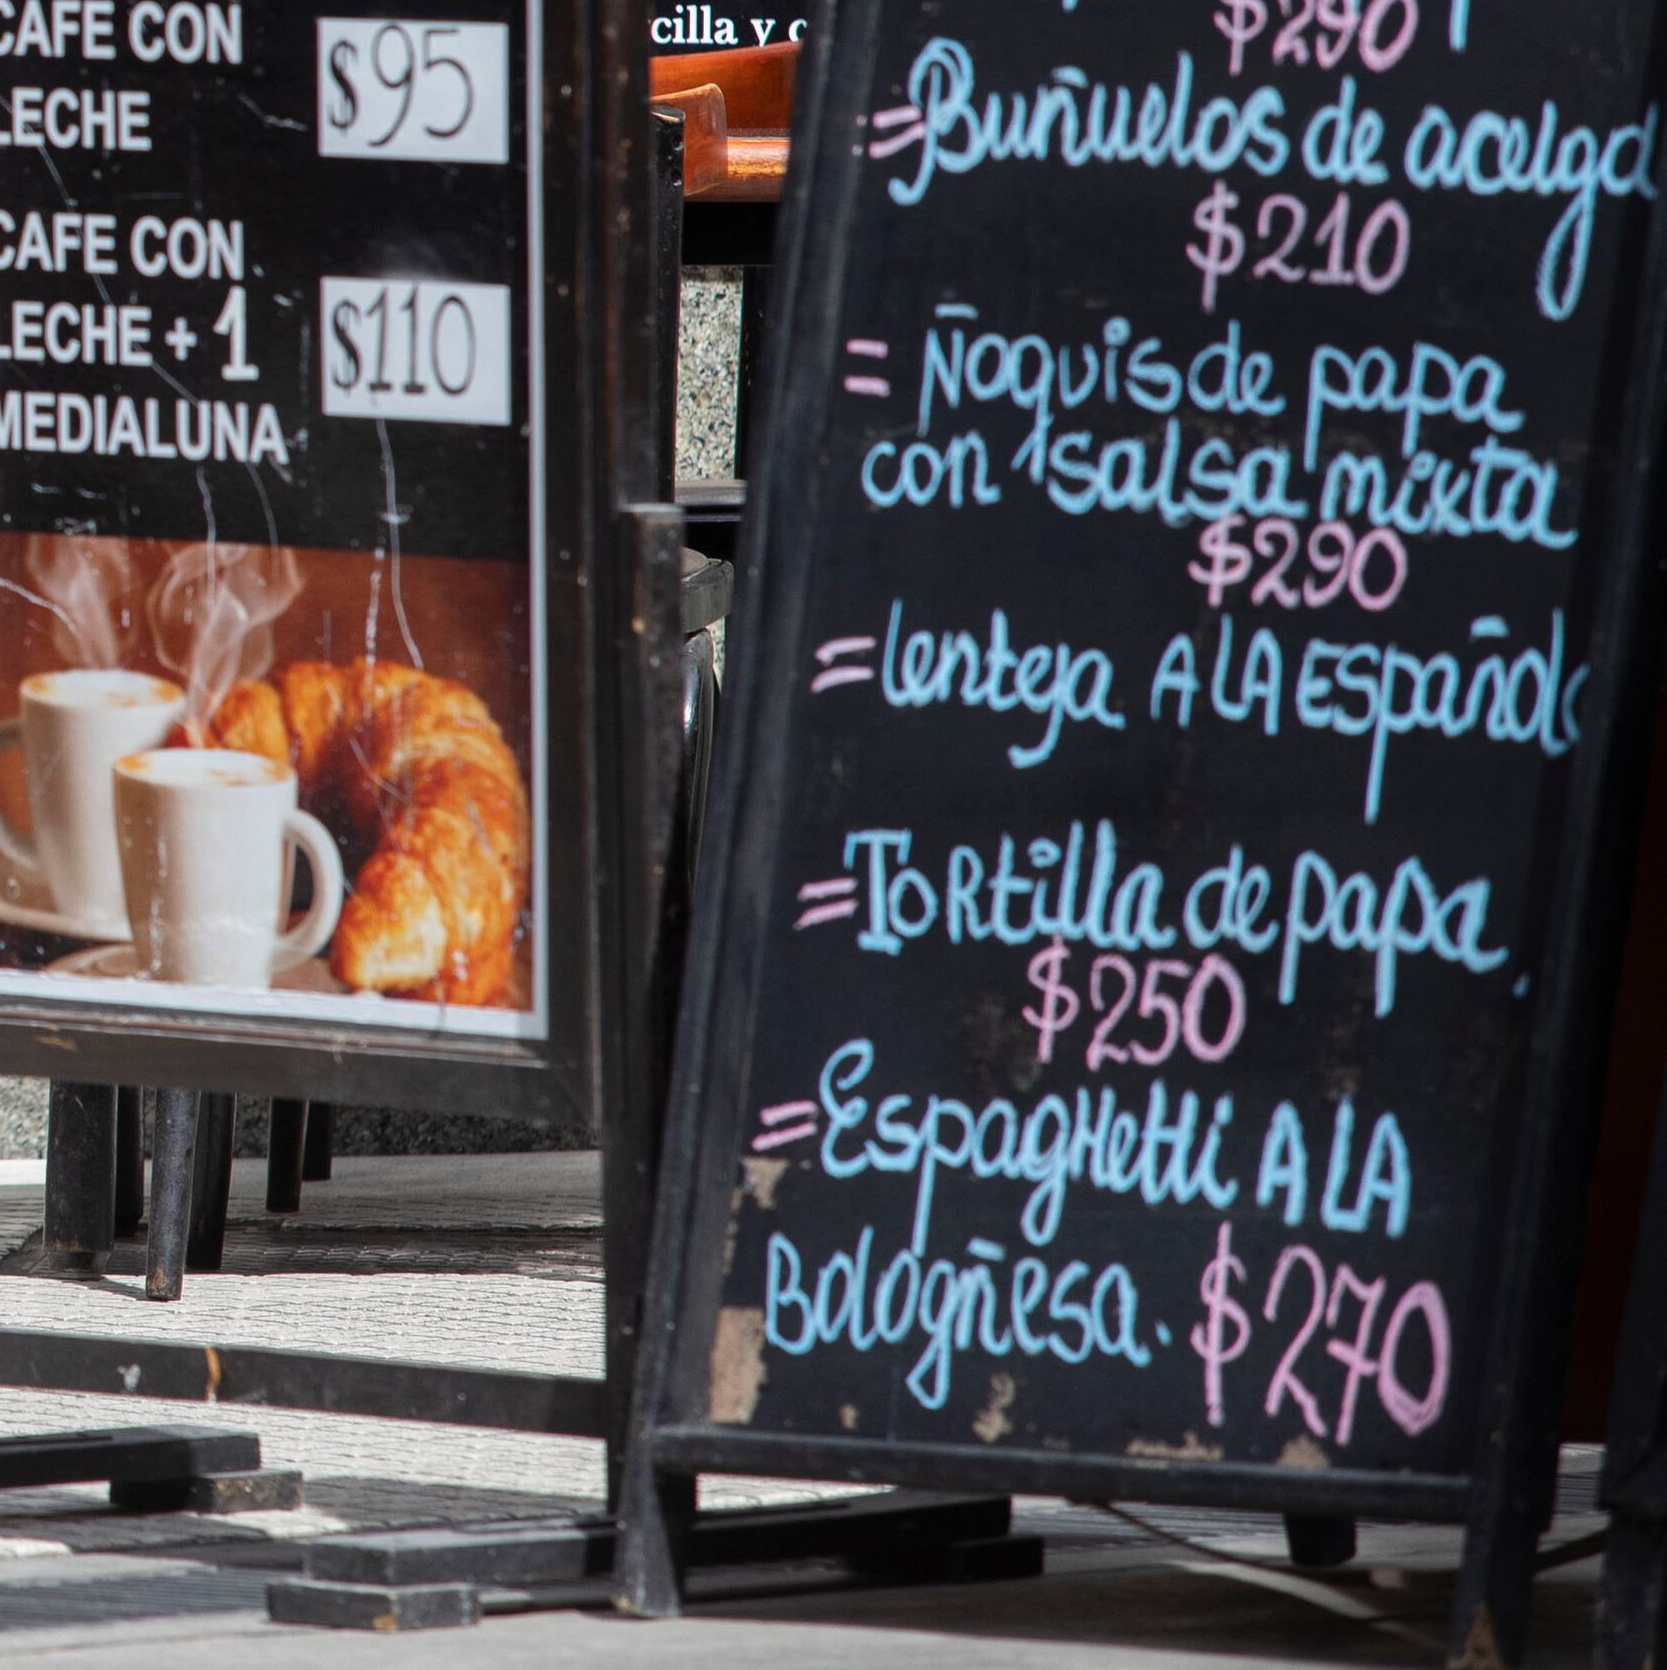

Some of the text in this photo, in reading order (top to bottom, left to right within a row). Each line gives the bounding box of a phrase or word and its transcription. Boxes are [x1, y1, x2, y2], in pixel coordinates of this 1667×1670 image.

[127, 0, 245, 66] CON
[327, 22, 477, 149] $95
[888, 37, 1659, 323] Buñuelos de acelga
[128, 214, 246, 282] CON
[1184, 179, 1412, 315] $210
[212, 284, 262, 383] 1
[330, 285, 478, 397] $110
[1188, 318, 1286, 417] de
[1304, 340, 1525, 471] papa
[861, 428, 1000, 509] con
[1319, 435, 1579, 550] mixta
[1187, 512, 1410, 612] $290
[1149, 631, 1200, 730] A
[1181, 842, 1280, 952] de
[1022, 932, 1248, 1071] $250
[1254, 1099, 1307, 1228] A
[1319, 1093, 1414, 1238] LA
[1189, 1219, 1453, 1448] $270
